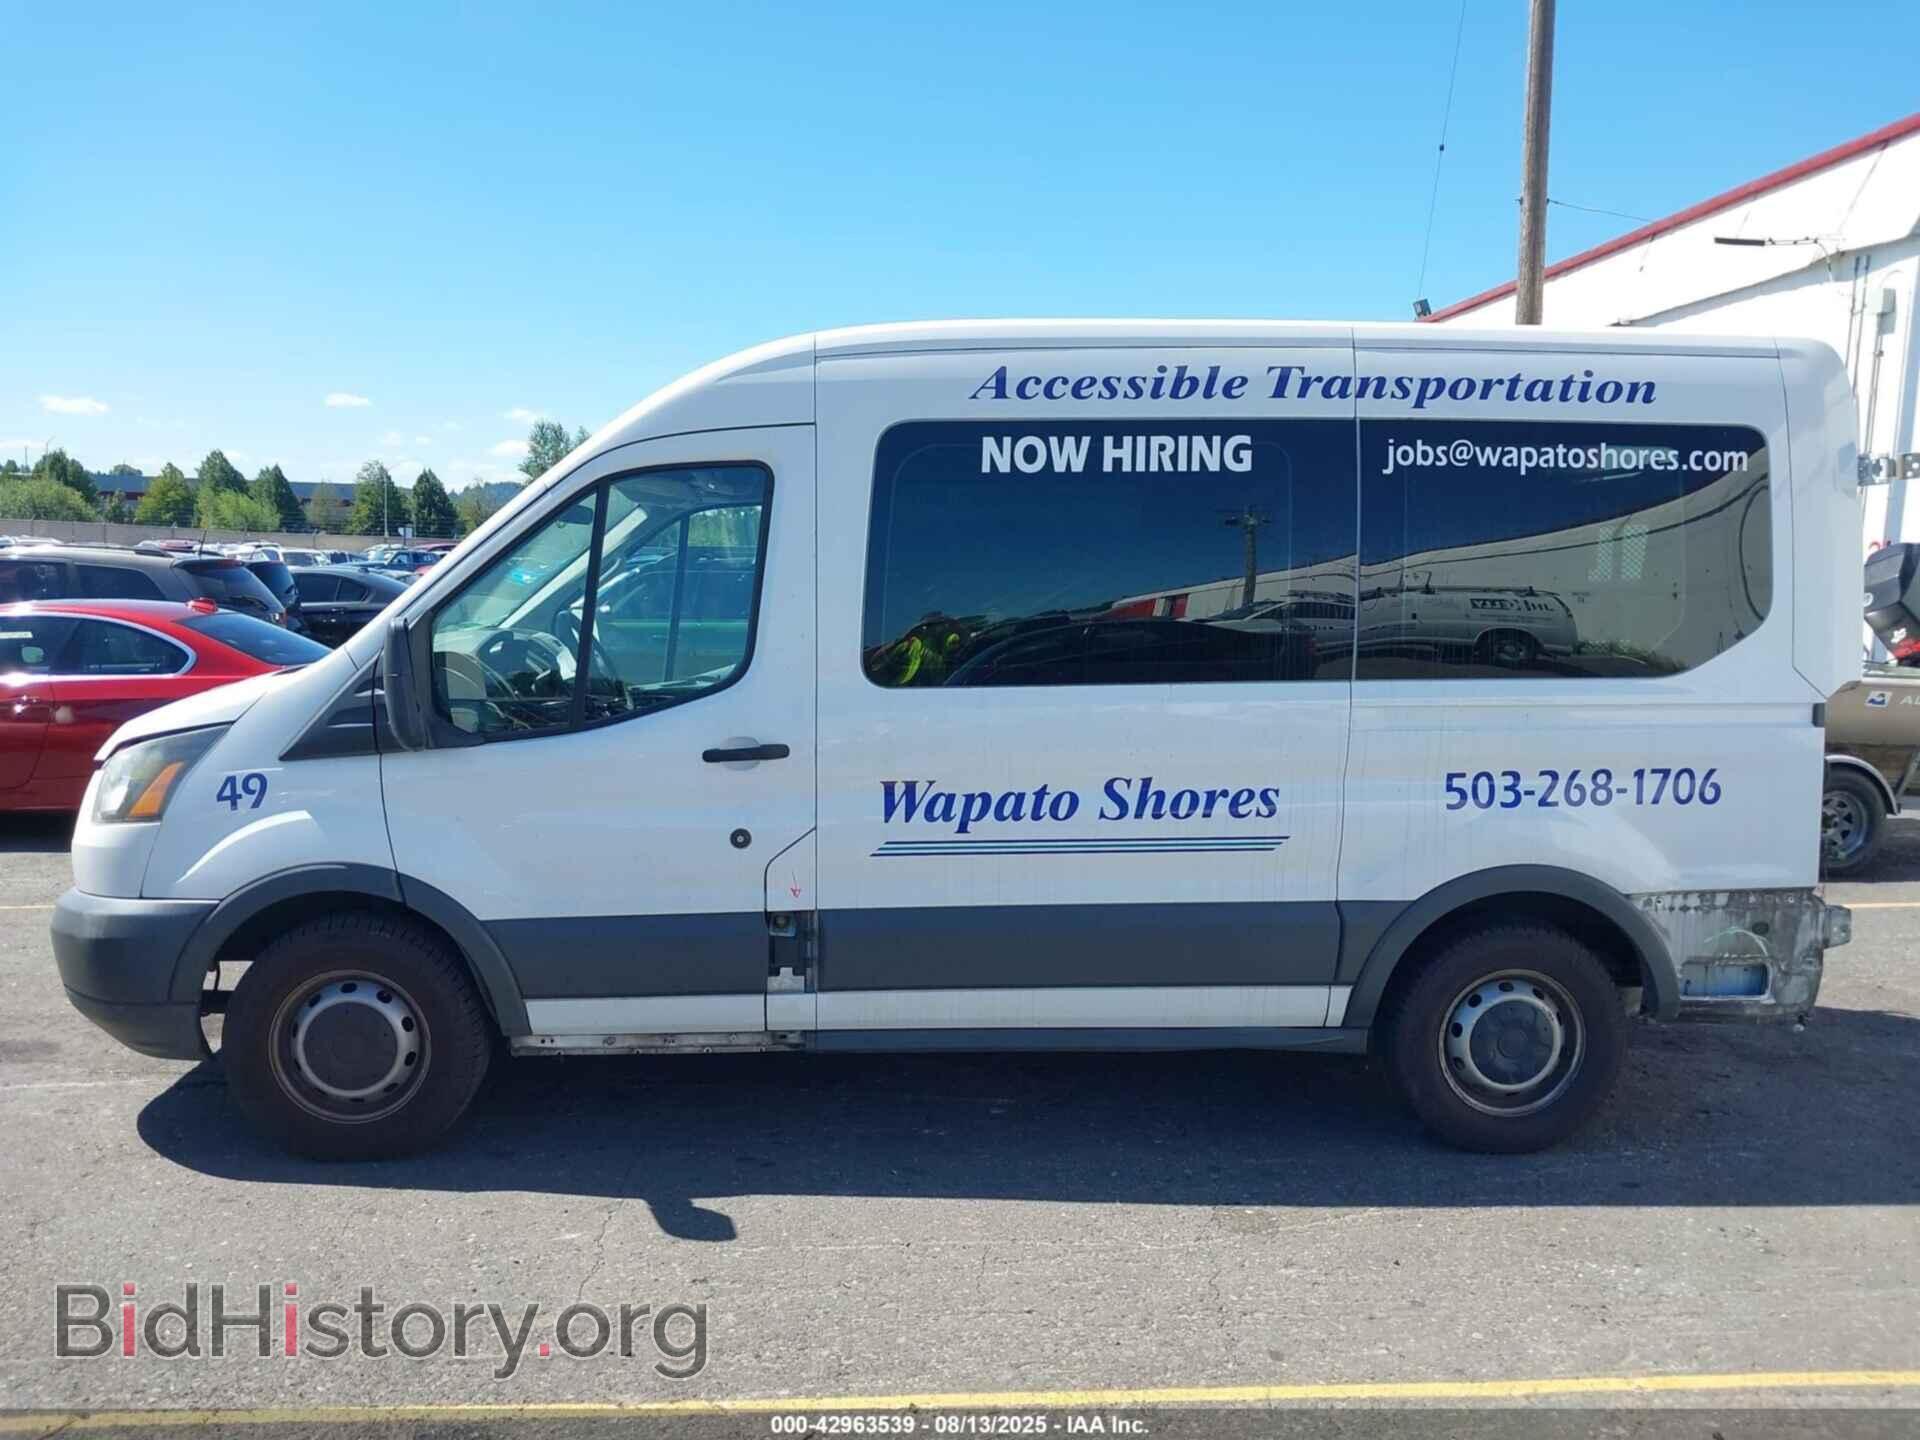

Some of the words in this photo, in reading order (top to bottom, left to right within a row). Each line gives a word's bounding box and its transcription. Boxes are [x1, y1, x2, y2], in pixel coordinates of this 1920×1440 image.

[969, 365, 1250, 402] Accessible
[1266, 366, 1657, 409] Transportation
[981, 435, 1091, 473] NOW
[1102, 434, 1253, 473] HIRING
[1382, 438, 1749, 475] jobs@wapatoshores.com
[215, 772, 268, 812] 49
[880, 779, 1080, 834] Wapato
[1098, 776, 1280, 821] Shores
[1445, 767, 1722, 810] 503-268-1706
